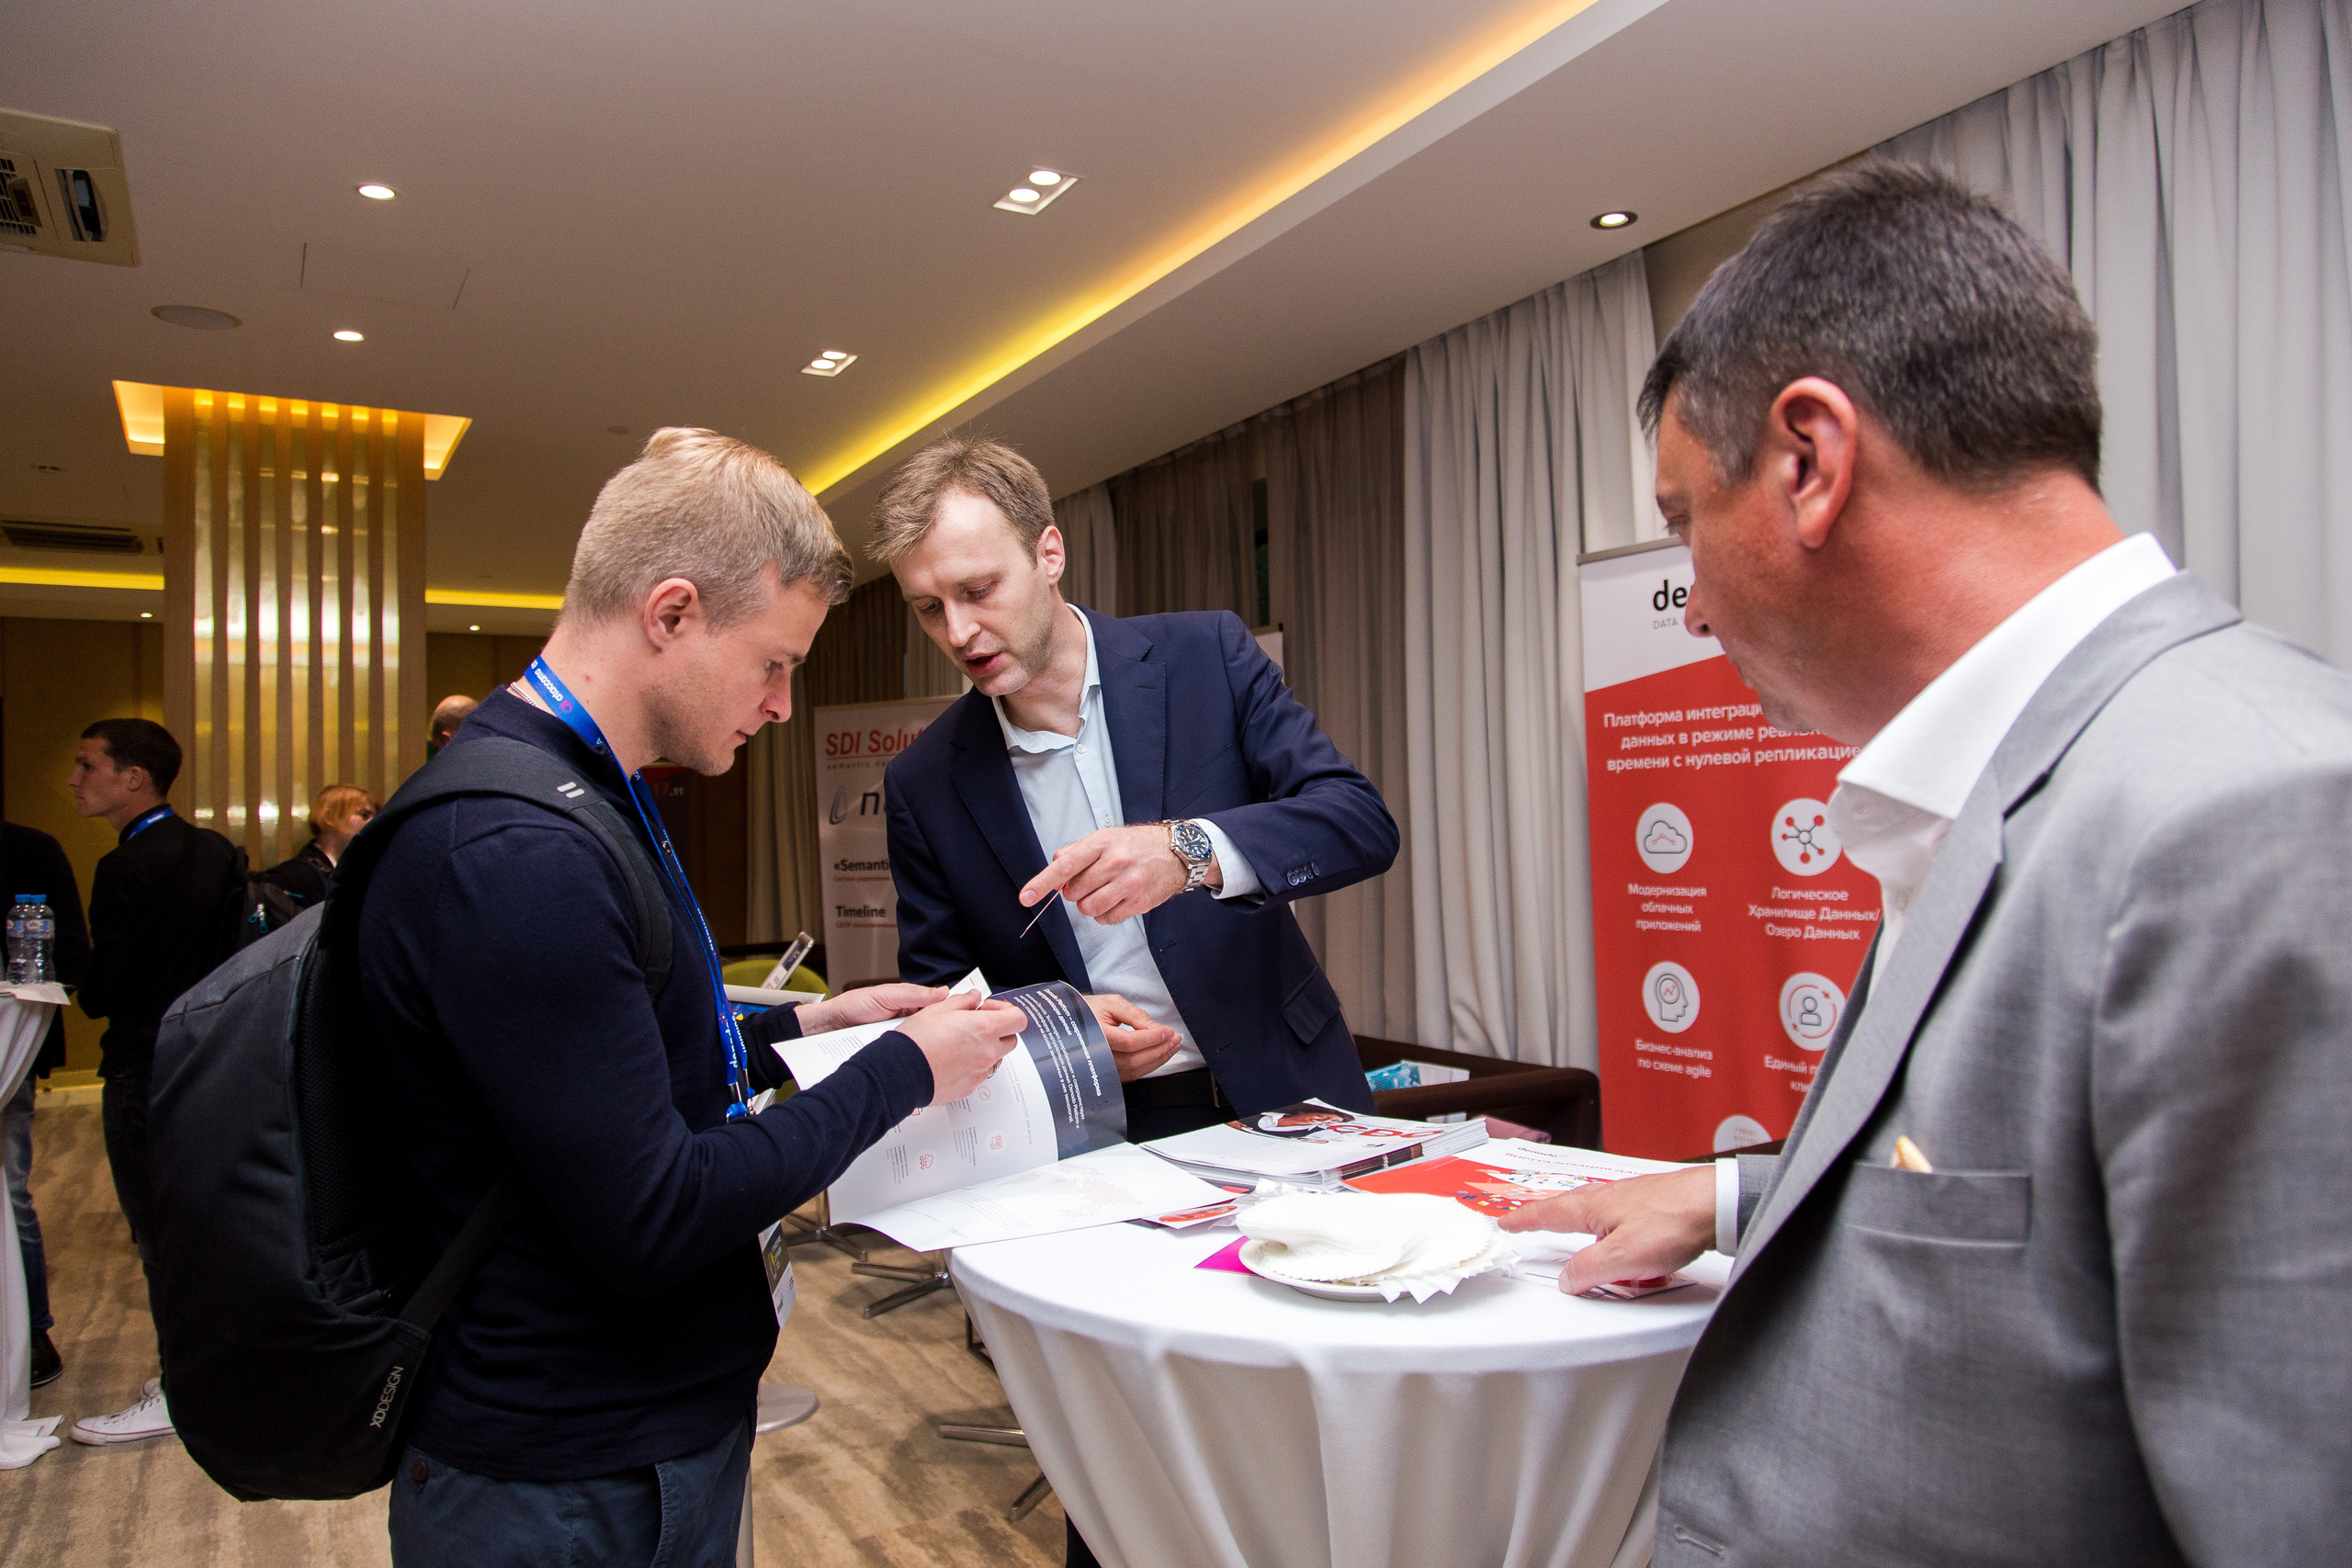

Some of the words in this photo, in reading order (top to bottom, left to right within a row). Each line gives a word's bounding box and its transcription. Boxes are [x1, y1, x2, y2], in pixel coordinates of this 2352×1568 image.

[1653, 580, 1690, 611] de
[1654, 617, 1679, 630] DATA
[1603, 710, 1683, 728] Платформа
[825, 731, 861, 756] SDI
[1621, 733, 1675, 750] данных
[1679, 732, 1689, 744] в
[1692, 727, 1754, 747] режиме
[1607, 756, 1669, 773] времени
[1673, 755, 1682, 767] с
[1686, 748, 1751, 770] нулевой
[1627, 883, 1707, 897] Модернизация
[1771, 887, 1849, 901] Логическое
[835, 905, 886, 918] Timeline
[1641, 901, 1694, 915] облачных
[1748, 905, 1816, 920] Хранилище
[1635, 919, 1702, 932] приложений
[1765, 923, 1802, 940] Озеро
[1804, 924, 1860, 941] Данных
[1057, 1015, 1072, 1035] данных
[1056, 998, 1070, 1016] Platform
[1070, 1021, 1090, 1059] современная
[1087, 1059, 1101, 1096] платформа
[1635, 1039, 1713, 1060] Бизнес-анализ
[1637, 1058, 1651, 1068] по
[1653, 1062, 1684, 1075] схеме
[1686, 1065, 1712, 1078] agile
[1764, 1055, 1807, 1074] Единый
[1057, 1040, 1074, 1073] разрабатывает
[1072, 1078, 1084, 1119] совершенствует
[1061, 1066, 1070, 1083] данных
[1068, 1083, 1076, 1103] Denodo
